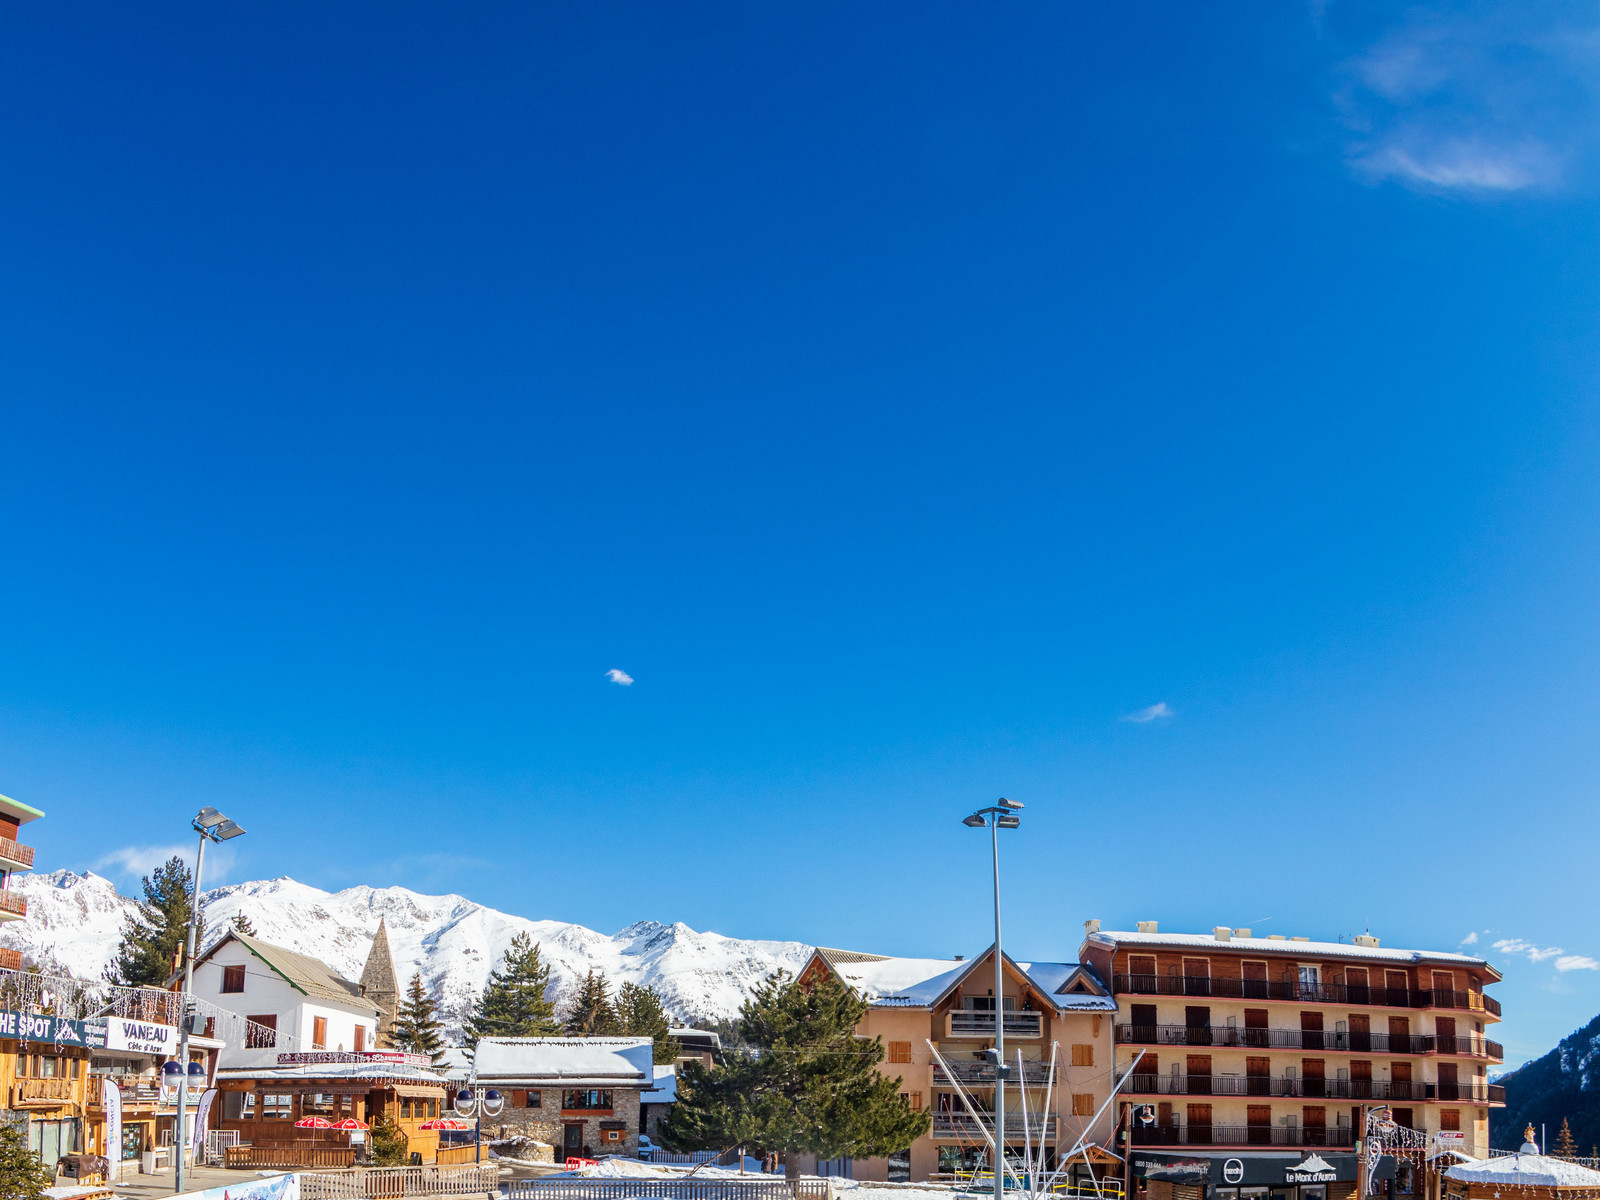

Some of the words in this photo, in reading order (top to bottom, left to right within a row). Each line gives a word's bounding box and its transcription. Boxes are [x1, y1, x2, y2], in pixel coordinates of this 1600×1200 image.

[18, 1015, 51, 1038] SPOT
[122, 1022, 168, 1043] VANEAU
[1286, 1173, 1295, 1182] Le
[1295, 1173, 1312, 1182] Mont
[1313, 1173, 1336, 1181] d'Auron
